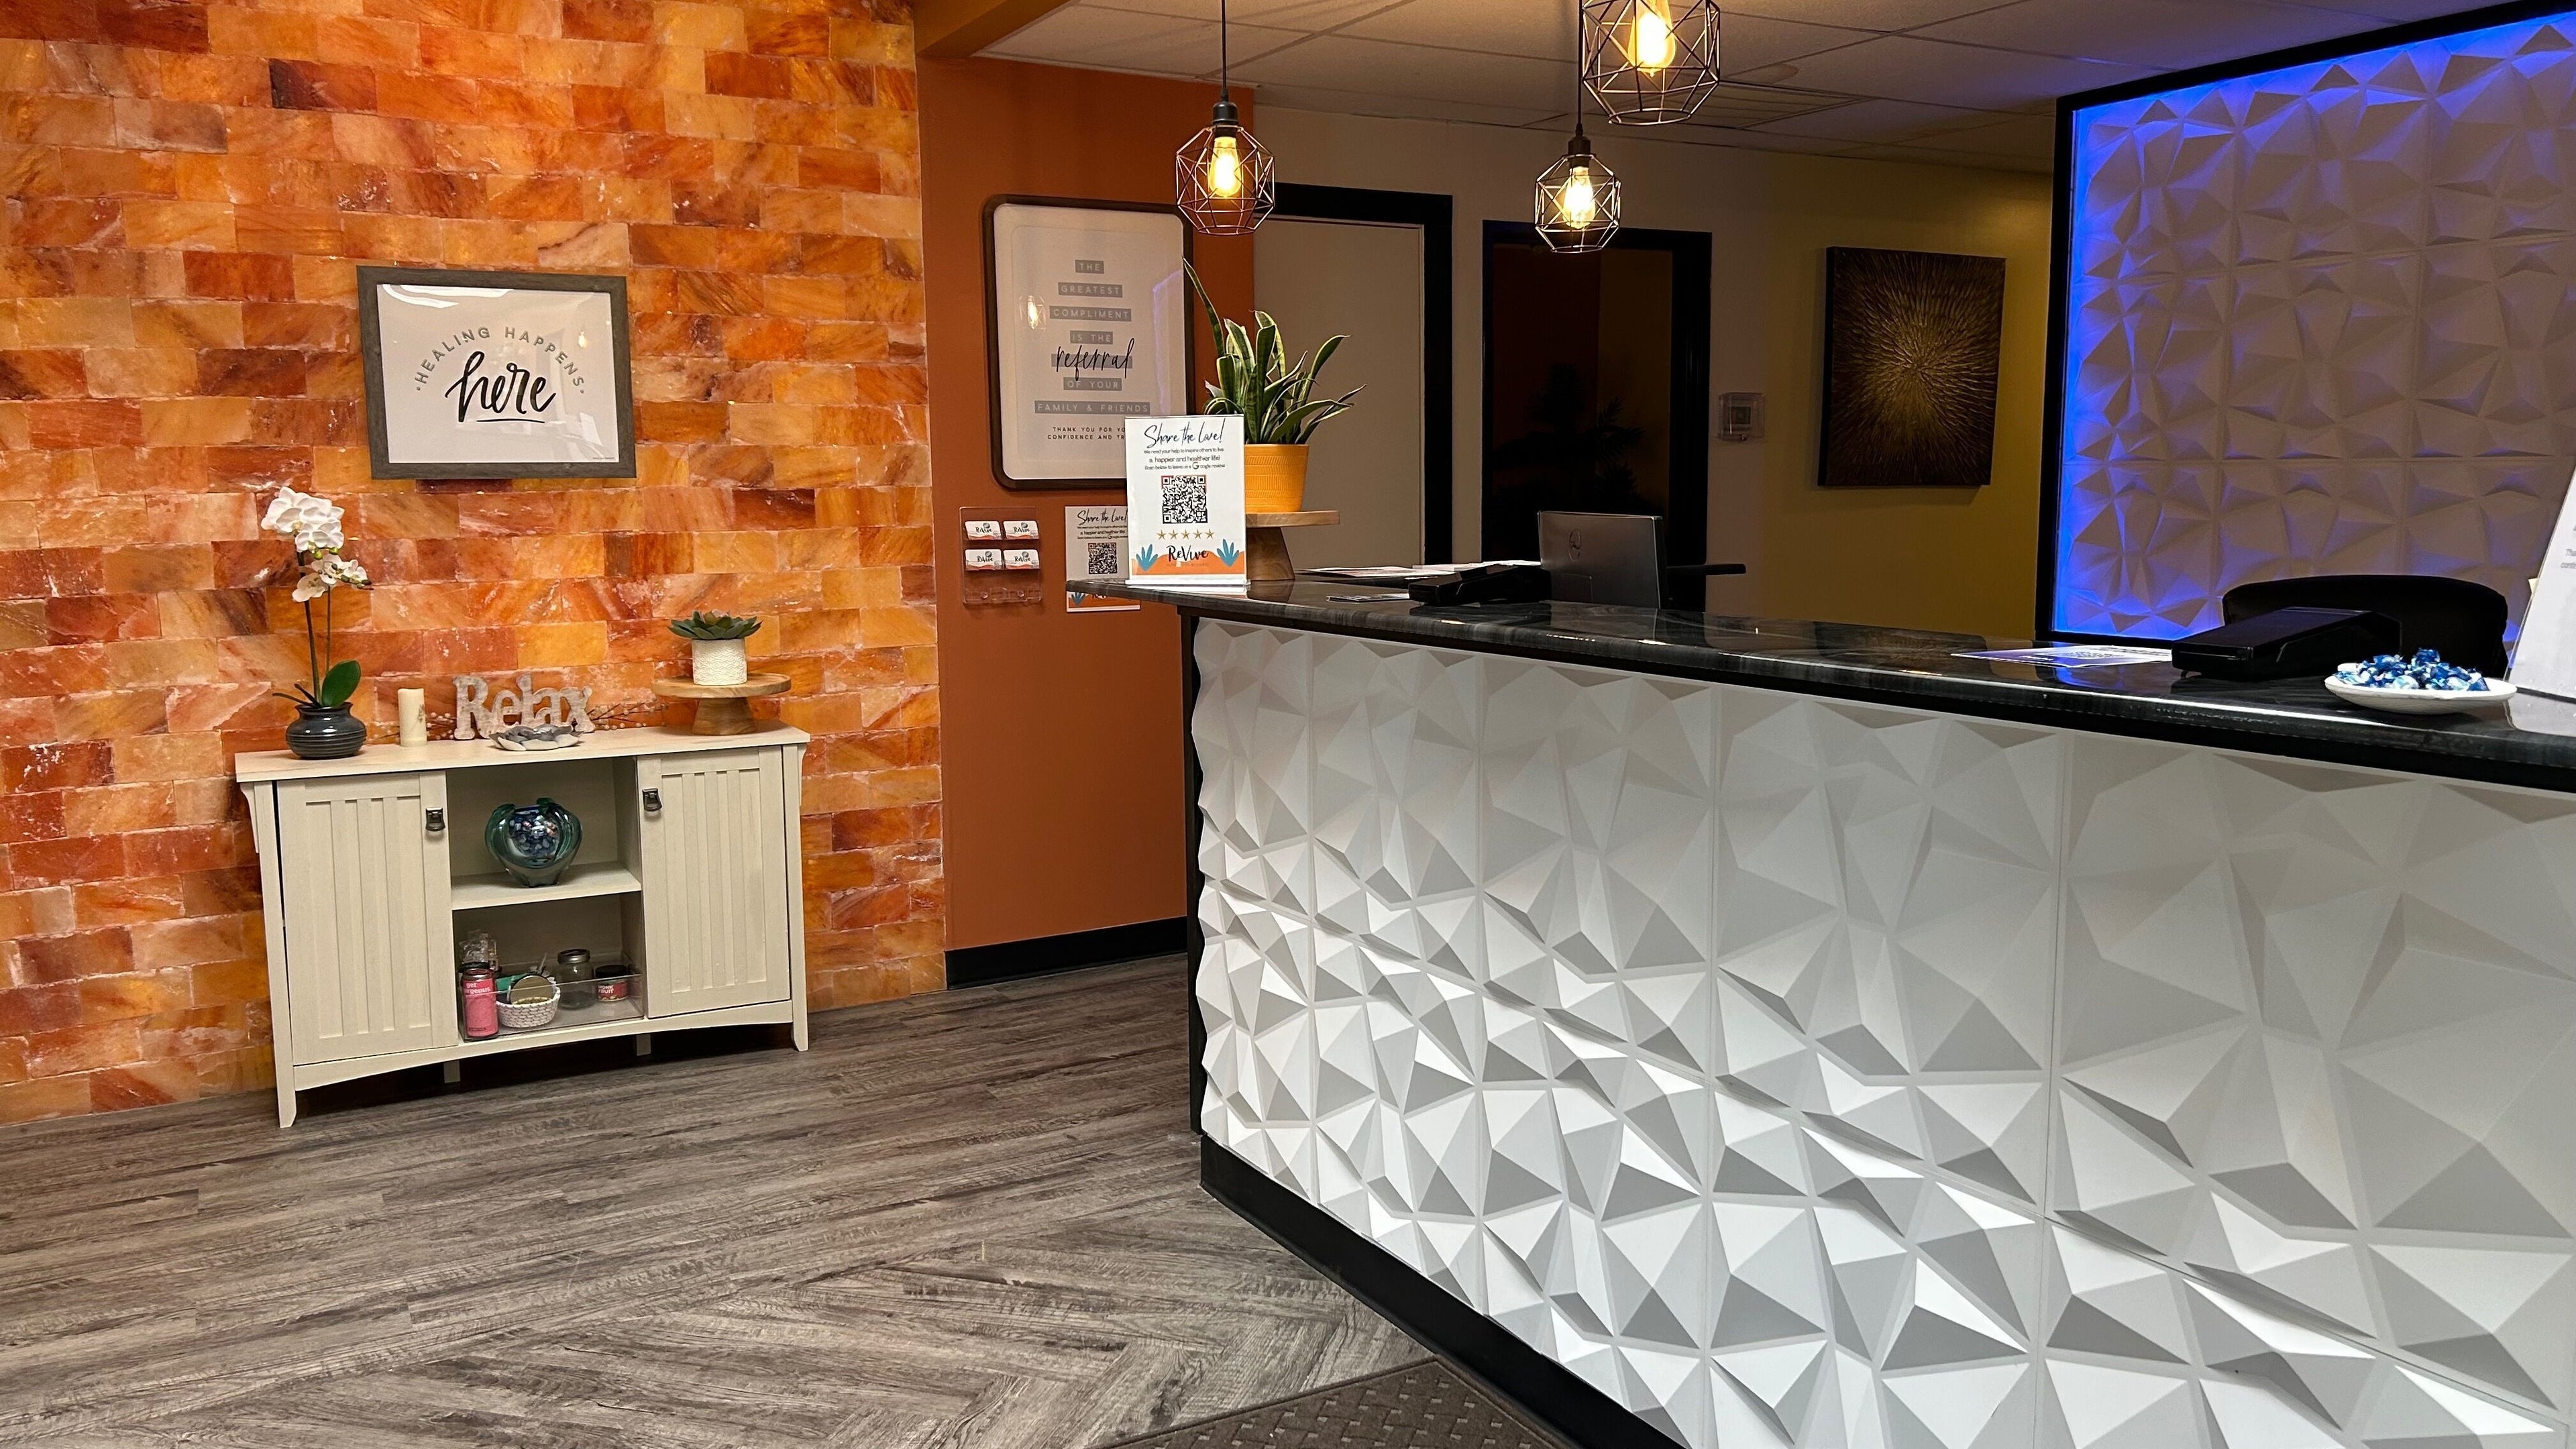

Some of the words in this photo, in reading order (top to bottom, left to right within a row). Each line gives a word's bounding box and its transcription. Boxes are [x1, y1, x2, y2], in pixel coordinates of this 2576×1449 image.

[1079, 262, 1101, 272] THE
[1061, 285, 1120, 295] GREATEST
[1053, 309, 1129, 319] COMPLIMENT
[1091, 334, 1111, 342] THE
[415, 327, 491, 384] HEALING
[504, 327, 585, 387] HAPPENS
[1056, 338, 1134, 382] referral
[444, 351, 557, 423] here
[1067, 380, 1081, 388] OF
[1089, 381, 1119, 389] YOUR
[1037, 404, 1079, 412] FAMILY
[1086, 404, 1092, 412] &
[1100, 405, 1148, 413] FRIENDS
[1144, 422, 1179, 449] Share
[1180, 421, 1195, 446] the
[1198, 418, 1226, 443] Love!
[1077, 508, 1100, 526] Share
[1100, 508, 1110, 524] the
[1166, 545, 1210, 562] ReVive
[451, 672, 596, 740] Relax
